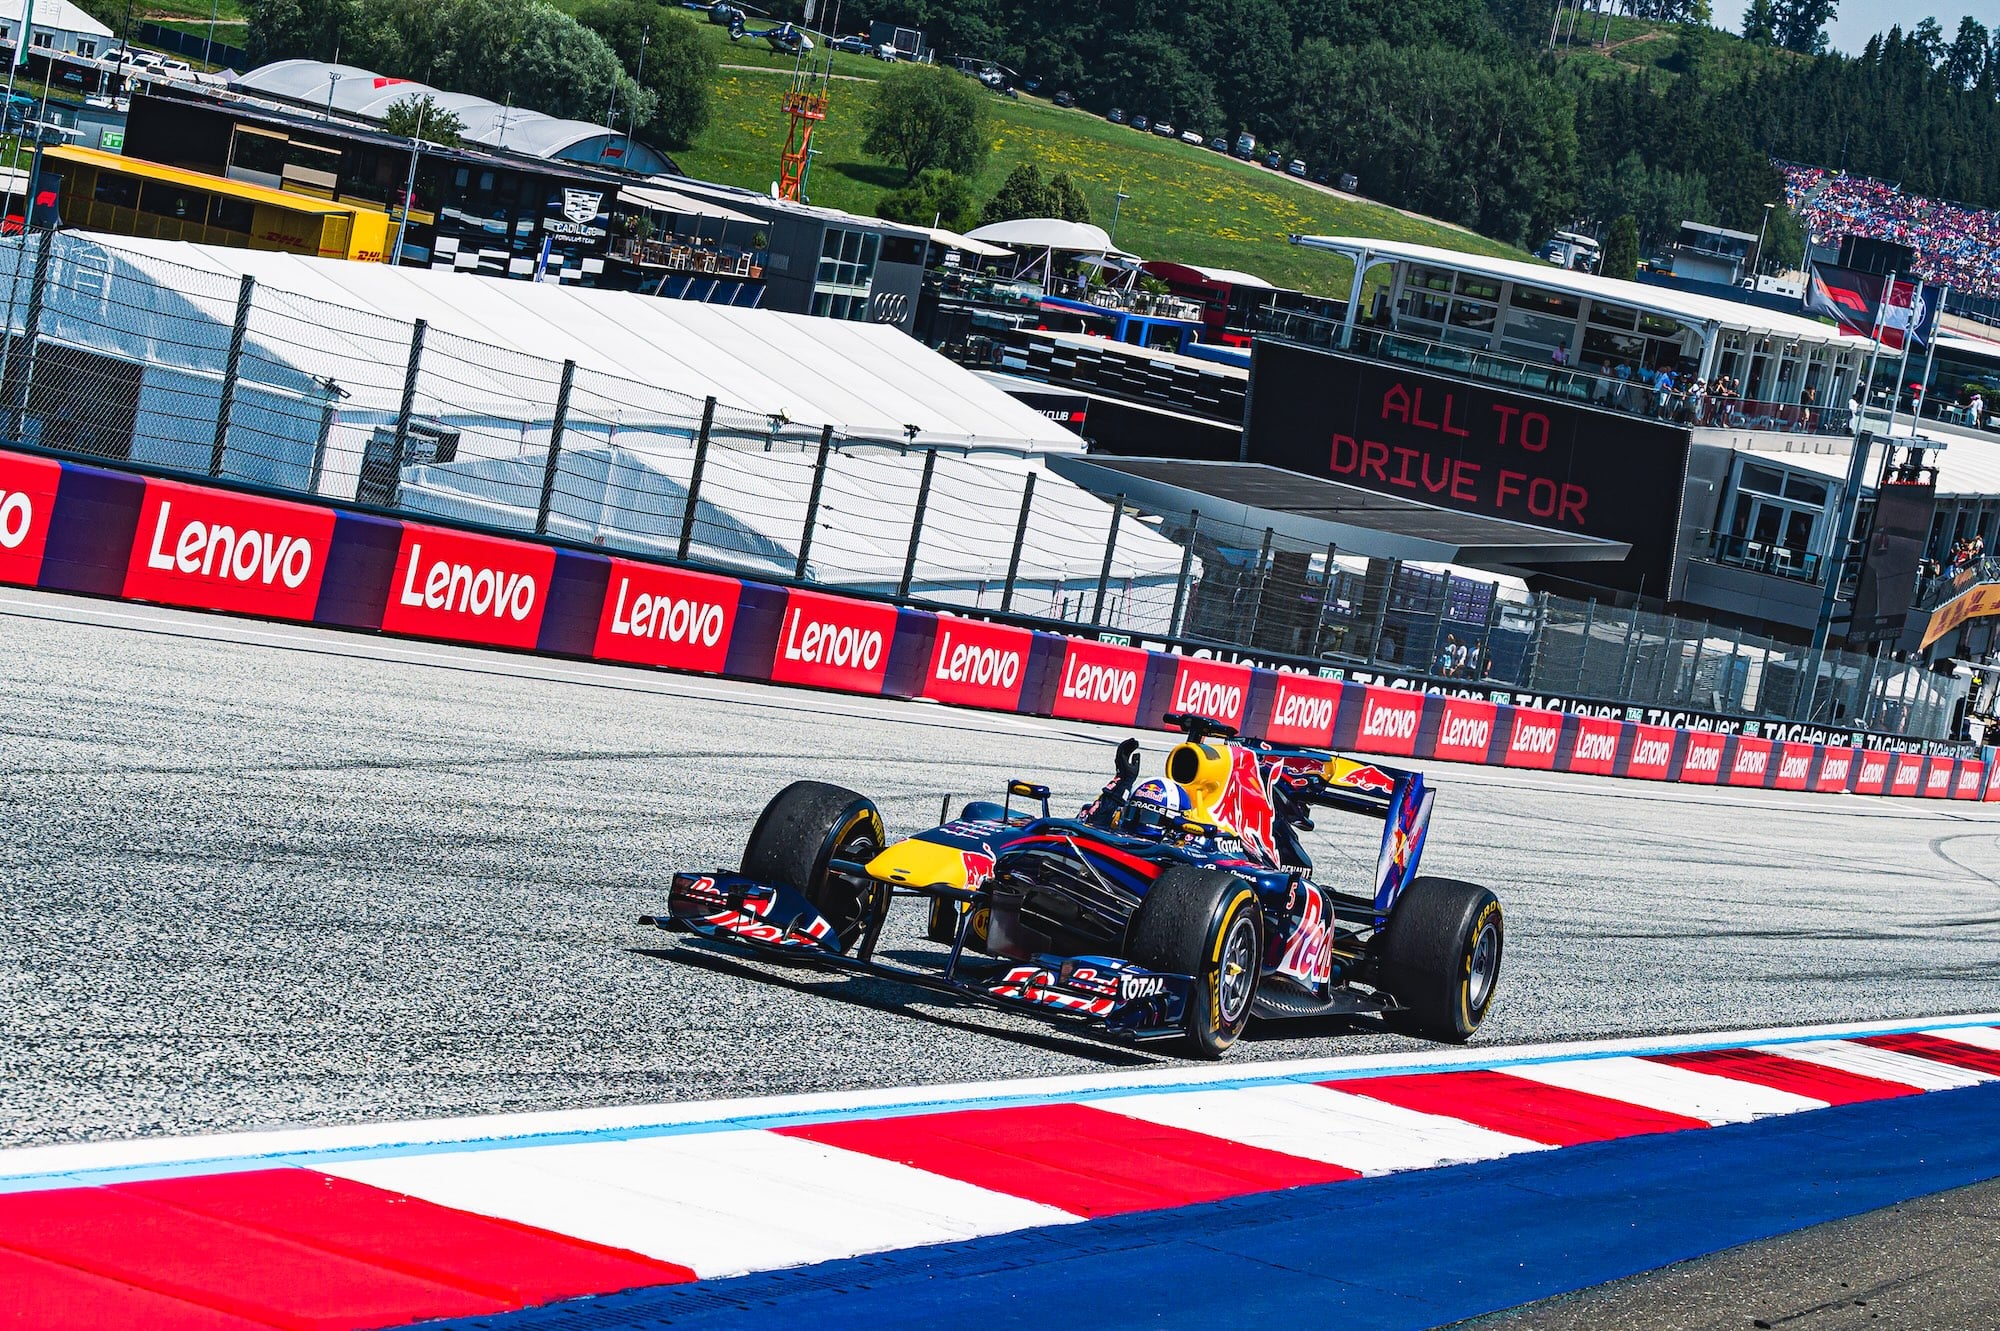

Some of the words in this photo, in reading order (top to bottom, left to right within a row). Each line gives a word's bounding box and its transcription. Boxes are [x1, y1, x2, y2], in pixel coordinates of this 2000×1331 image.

[556, 223, 597, 236] CADILLAC
[356, 250, 380, 262] DHL
[1046, 410, 1069, 421] CLUB
[1381, 383, 1470, 437] ALL
[1492, 404, 1550, 452] TO
[1330, 433, 1481, 502] DRIVE
[1496, 469, 1589, 525] FOR
[148, 502, 311, 587] Lenovo
[401, 544, 535, 620] Lenovo
[612, 578, 723, 646] Lenovo
[784, 608, 881, 670] Lenovo
[936, 628, 1021, 688] Lenovo
[1063, 653, 1136, 705] Lenovo
[1176, 670, 1240, 718] Lenovo
[1274, 686, 1332, 730] Lenovo
[1490, 692, 1509, 705] TAG
[1363, 699, 1415, 738] Lenovo
[1627, 709, 1642, 720] TAG
[1648, 709, 1740, 735] TAGHeuer
[1441, 710, 1488, 748] Lenovo
[1512, 718, 1556, 753] Lenovo
[1764, 723, 1848, 747] TAGHeuer
[1576, 727, 1614, 760] Lenovo
[1633, 733, 1669, 766] Lenovo
[1686, 741, 1719, 770] Lenovo
[1735, 745, 1766, 773] Lenovo
[1779, 752, 1808, 778] Lenovo
[1821, 755, 1848, 779] Lenovo
[1859, 759, 1884, 783] Lenovo
[1895, 761, 1919, 784] Lenovo
[1130, 800, 1166, 815] ORACLE
[1214, 837, 1243, 856] TOTAL
[1286, 882, 1298, 910] 5
[1120, 974, 1165, 1001] TOTAL
